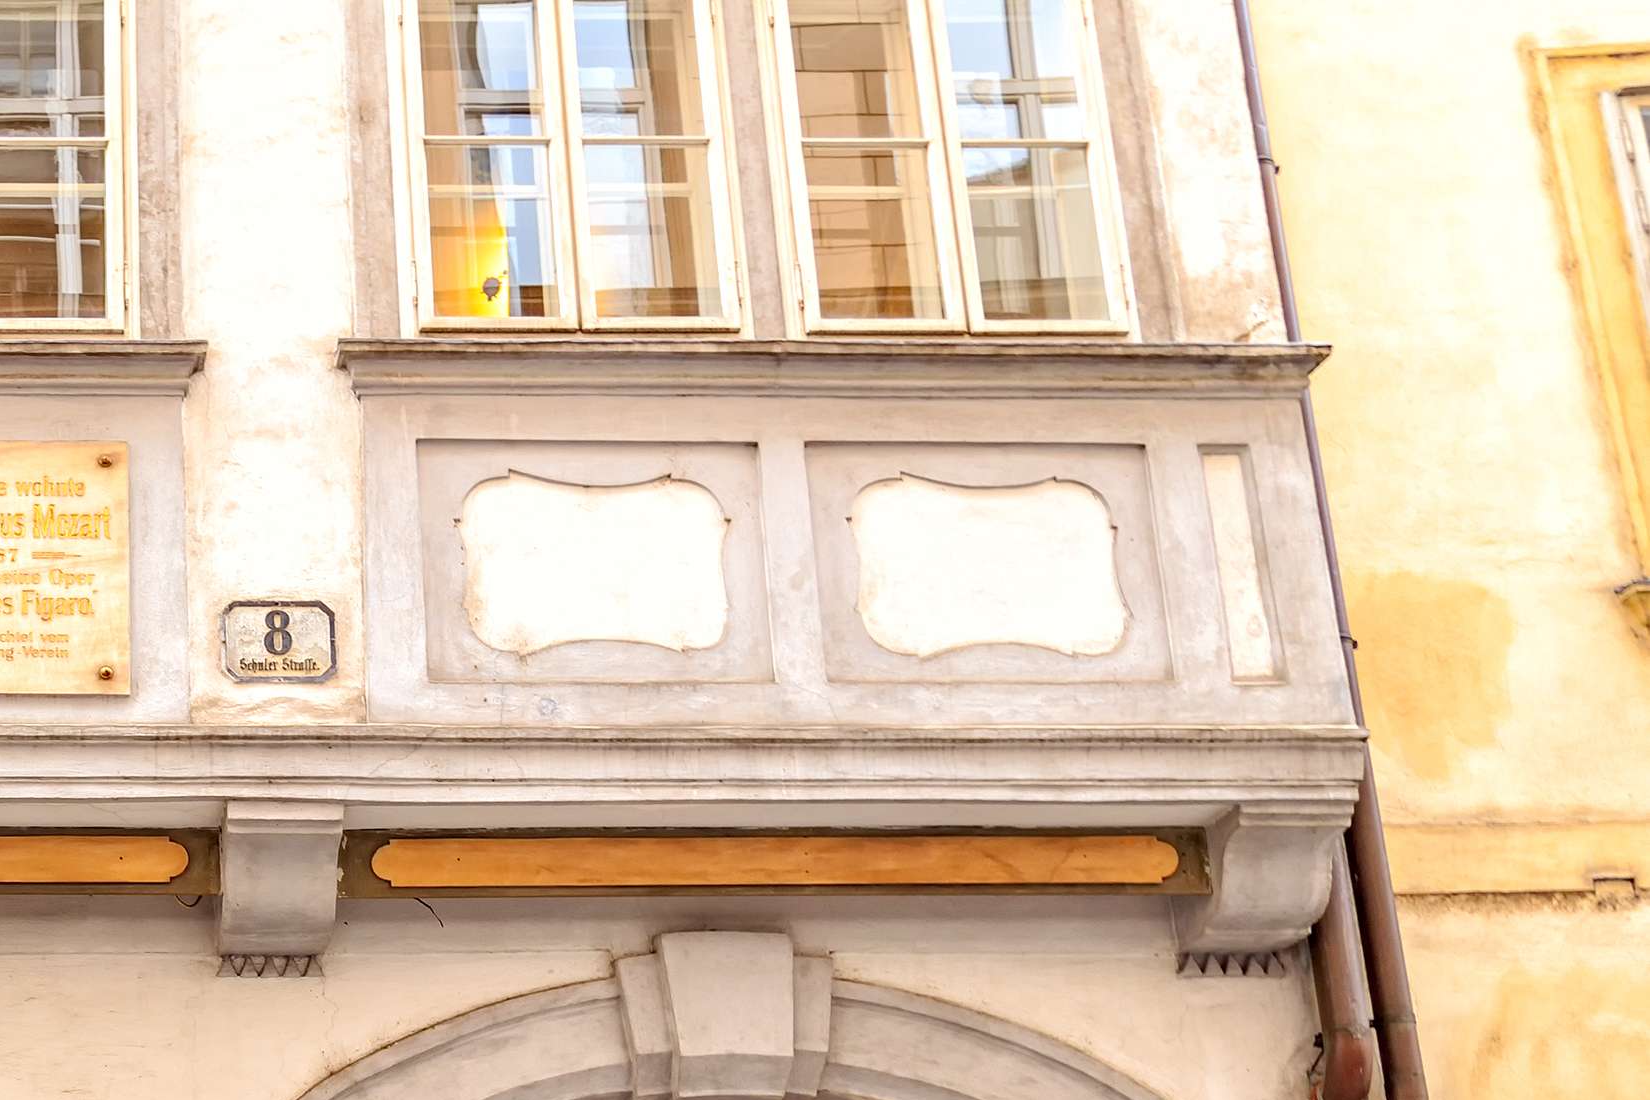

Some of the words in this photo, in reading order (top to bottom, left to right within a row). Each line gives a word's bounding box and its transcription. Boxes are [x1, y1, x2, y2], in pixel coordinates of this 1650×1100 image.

[15, 475, 86, 498] wohnte
[31, 503, 111, 541] Mozart
[48, 568, 95, 590] Oper
[39, 633, 70, 644] vom
[263, 609, 293, 656] 8
